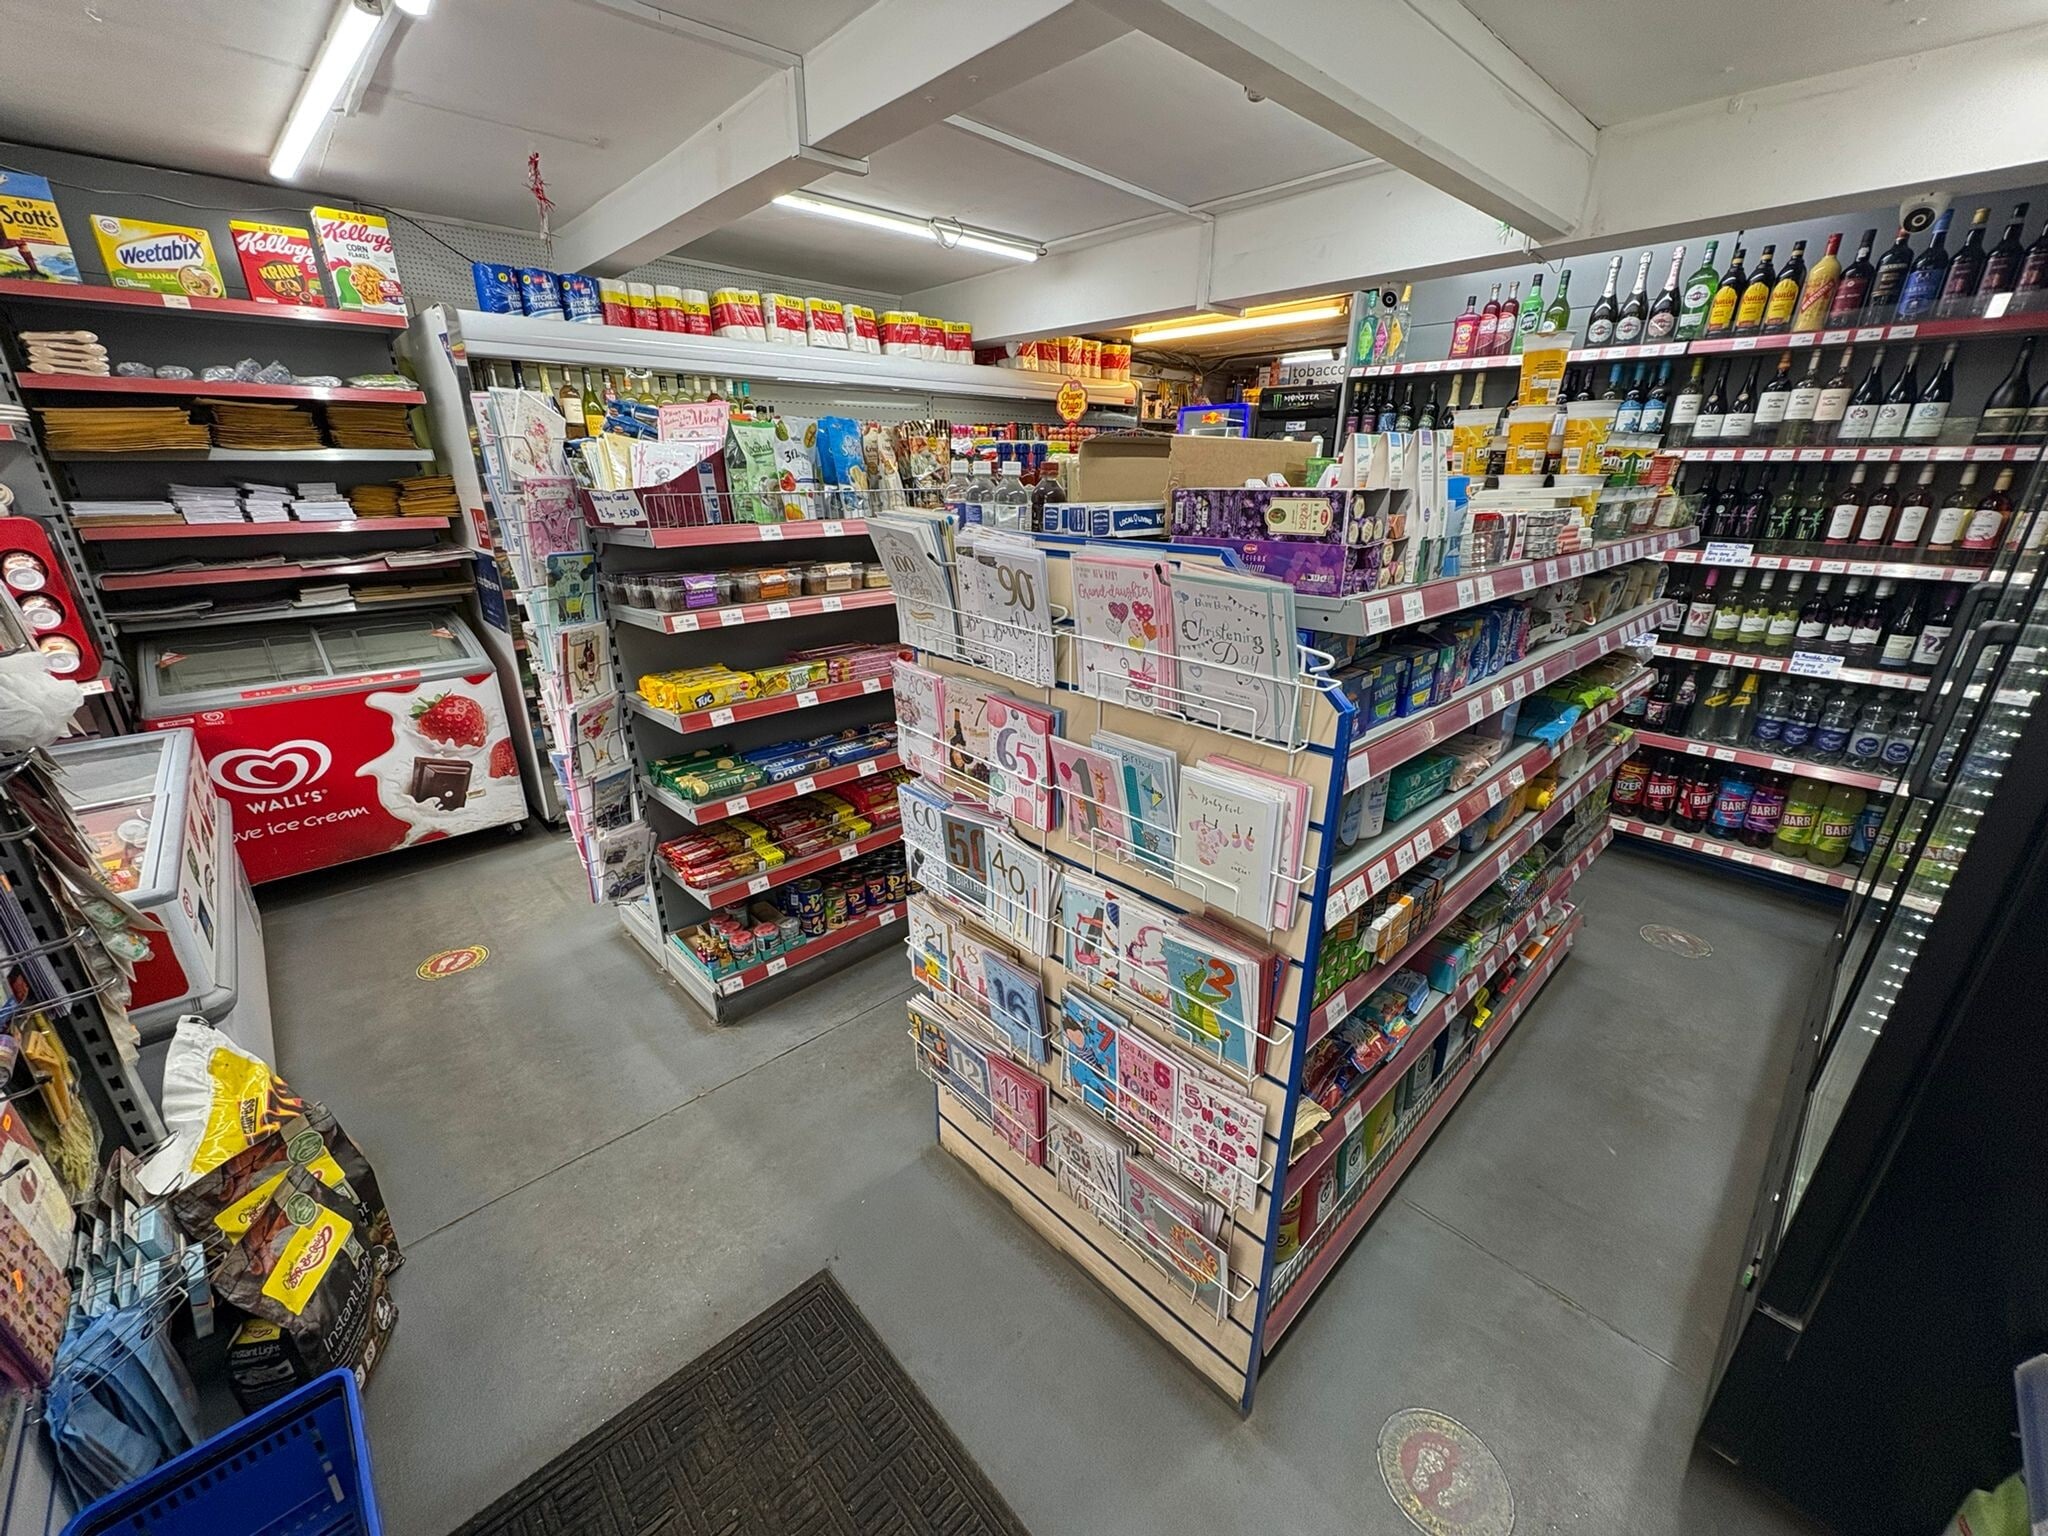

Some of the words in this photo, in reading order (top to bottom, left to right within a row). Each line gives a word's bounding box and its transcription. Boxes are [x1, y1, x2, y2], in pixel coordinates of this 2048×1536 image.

[1, 206, 58, 228] Scott's
[338, 213, 367, 223] £3.49
[120, 241, 201, 264] Weetabix
[346, 244, 368, 254] CORN
[259, 264, 302, 280] KRAVE
[688, 304, 701, 315] 75p
[1292, 364, 1346, 377] tobacco
[1061, 391, 1083, 400] Chupa
[1284, 393, 1320, 402] MONSTER
[1060, 401, 1082, 414] Chups
[1119, 516, 1134, 527] LOCAL
[891, 556, 916, 574] 100
[998, 565, 1036, 612] 90
[1182, 619, 1264, 654] Christening
[697, 696, 713, 708] TUC
[997, 728, 1037, 785] 65
[773, 764, 806, 781] OREO
[1617, 780, 1642, 791] TIZER
[1650, 785, 1673, 794] BARR
[246, 790, 323, 815] WALL'S
[1201, 795, 1223, 813] Baby
[1224, 802, 1245, 815] Girl
[1721, 801, 1747, 811] BARR
[1751, 805, 1778, 816] BARR
[913, 801, 937, 832] 60
[1784, 814, 1811, 826] BARR
[267, 819, 300, 836] ice
[992, 846, 1024, 895] 40
[925, 923, 943, 953] 21
[1206, 958, 1236, 999] 2
[993, 978, 1032, 1027] 16
[1097, 1020, 1115, 1052] 7
[952, 1047, 984, 1093] 12
[1154, 1061, 1171, 1090] 6
[999, 1077, 1022, 1115] 11
[1184, 1083, 1203, 1110] 5
[323, 1290, 359, 1352] Instant
